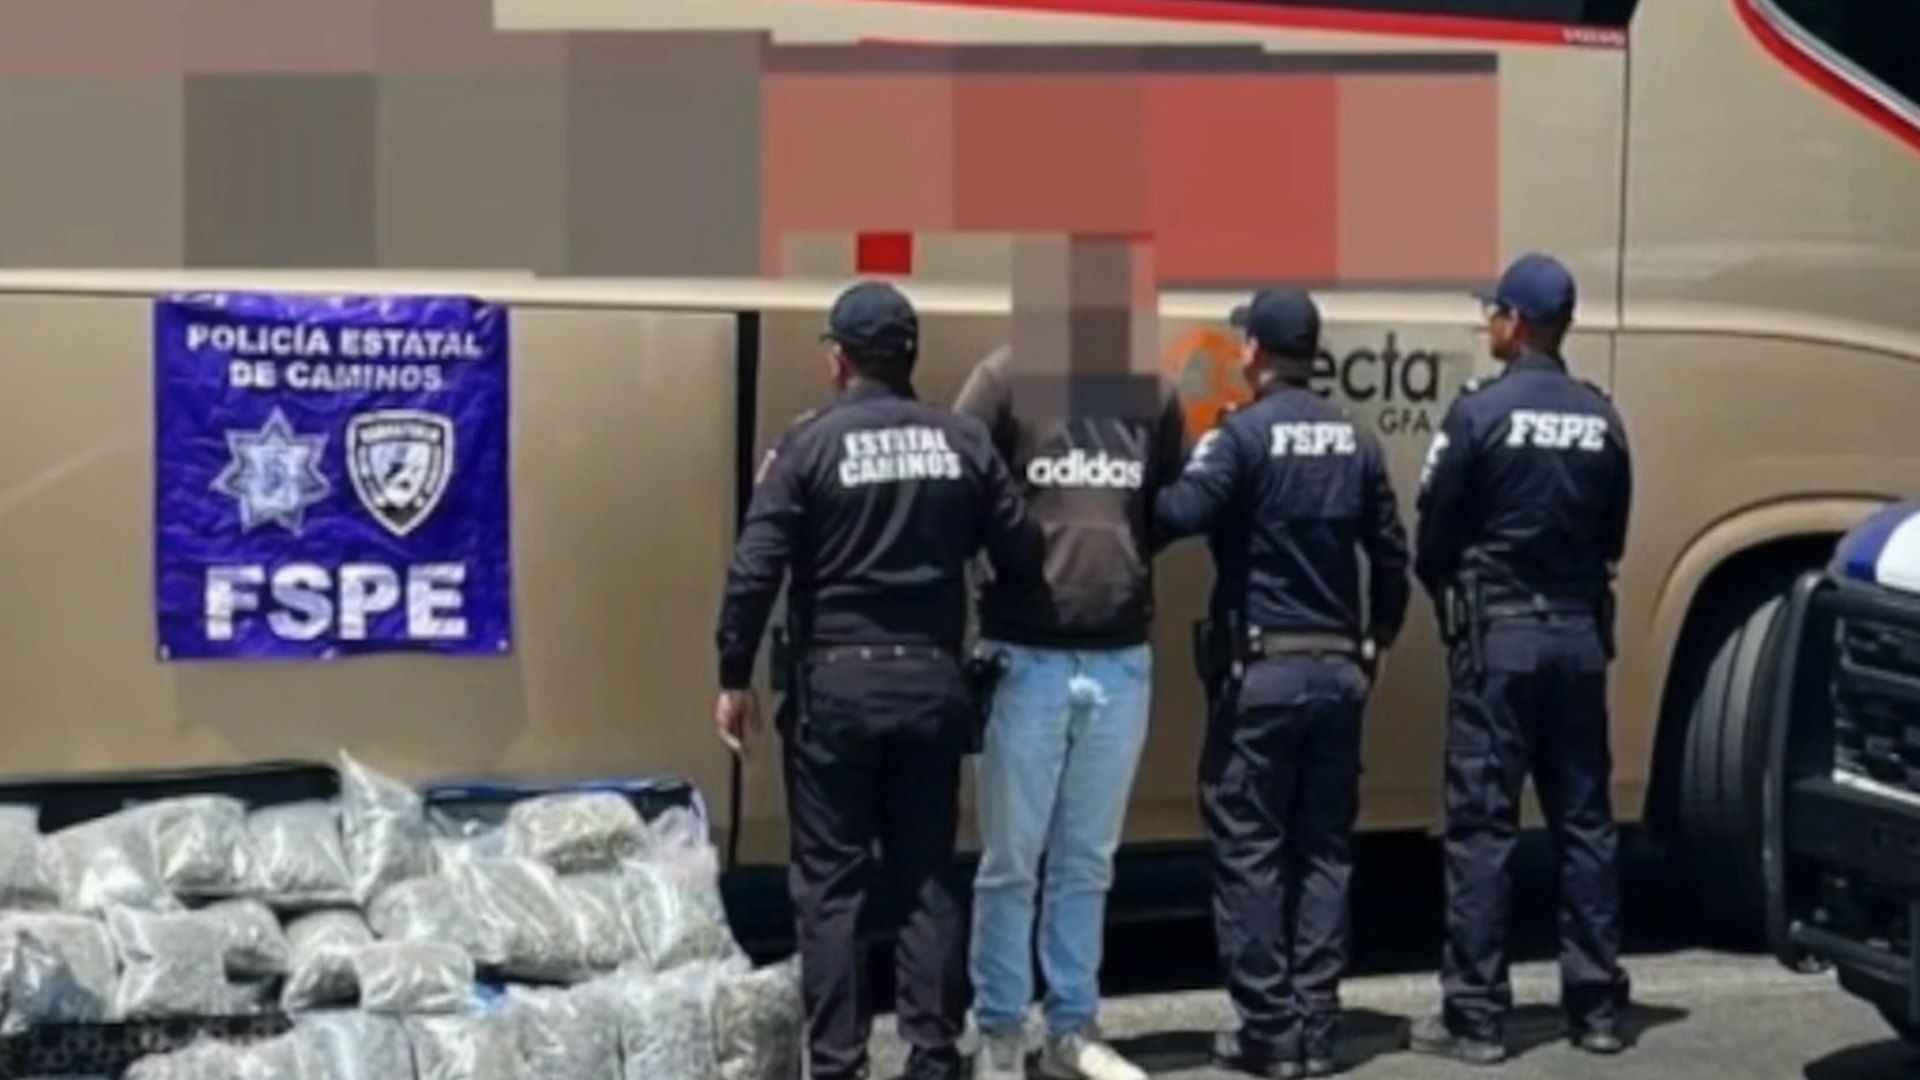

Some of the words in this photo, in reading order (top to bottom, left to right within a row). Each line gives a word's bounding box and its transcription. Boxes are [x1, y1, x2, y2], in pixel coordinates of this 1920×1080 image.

[187, 324, 330, 355] POLICÍA
[339, 328, 484, 357] ESTATAL
[229, 360, 276, 389] DE
[286, 363, 443, 391] CAMINOS
[1306, 329, 1439, 402] ecta
[1270, 422, 1356, 456] FSPE
[1507, 410, 1607, 451] FSPE
[1027, 449, 1144, 488] adidas
[205, 562, 467, 640] FSPE
